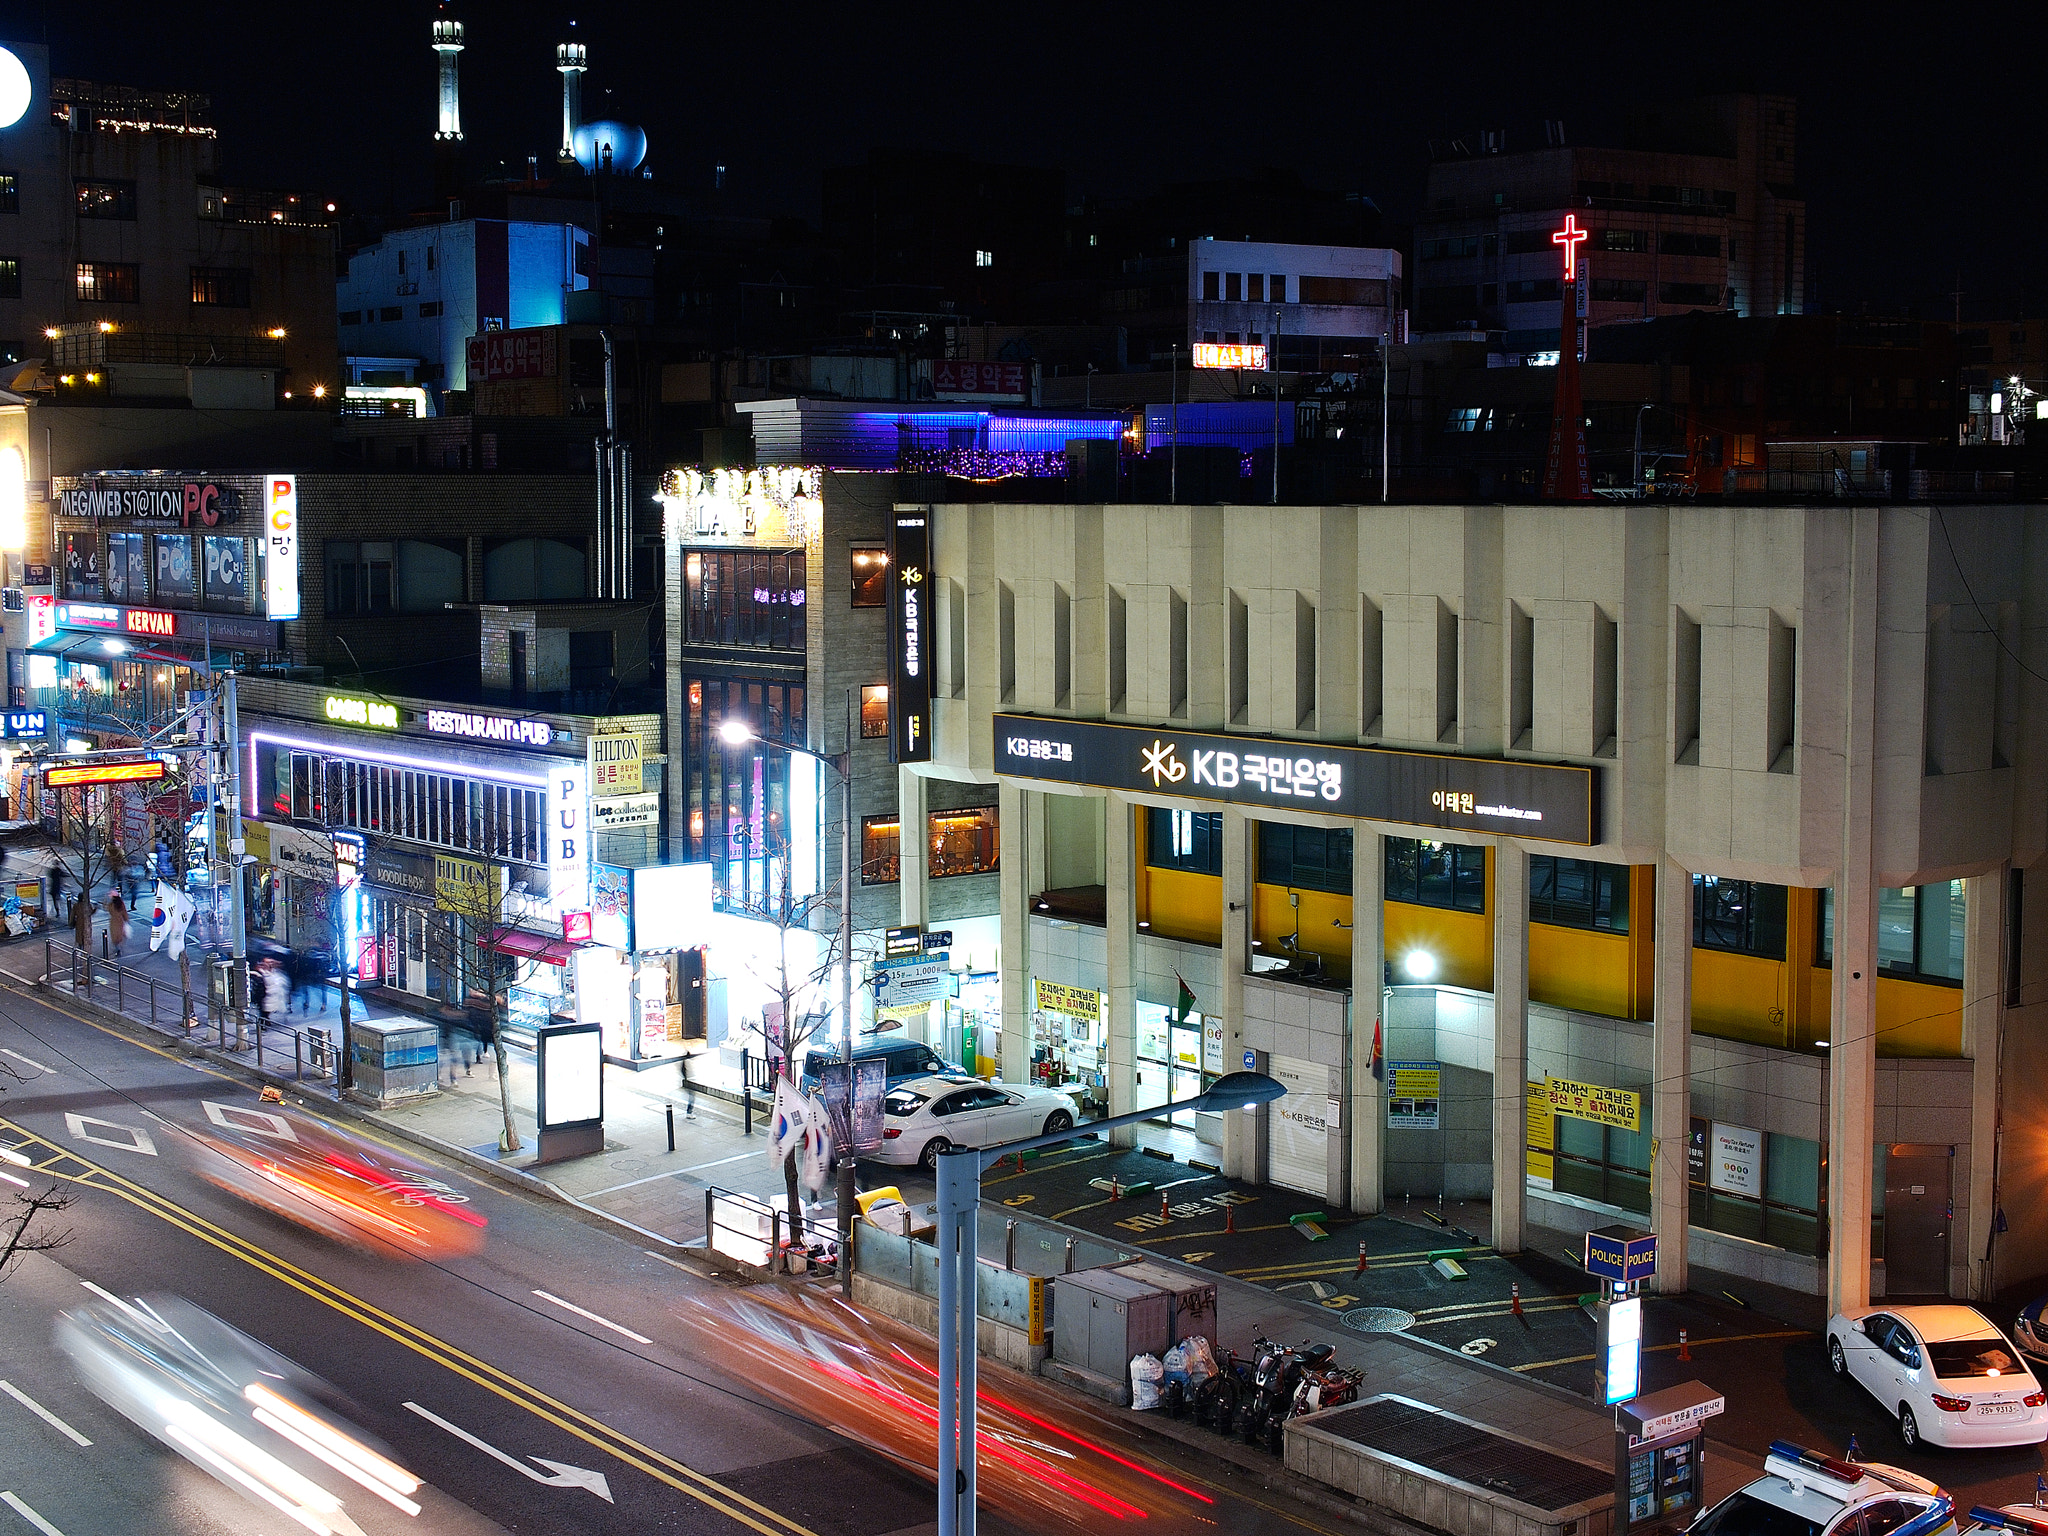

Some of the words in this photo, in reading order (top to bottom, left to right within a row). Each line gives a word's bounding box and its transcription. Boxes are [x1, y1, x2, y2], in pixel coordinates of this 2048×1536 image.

[469, 341, 488, 375] 약
[490, 336, 543, 374] 소명약국
[937, 364, 1024, 392] 소명약국
[60, 490, 122, 517] MEGAWEB
[127, 610, 173, 635] KERVAN
[368, 703, 398, 728] BAR
[594, 738, 639, 762] HILTON
[1007, 736, 1073, 762] KB금융그룹
[597, 765, 618, 784] 힐튼
[1193, 748, 1342, 801] KB국민은행
[595, 804, 613, 817] Lee
[1432, 790, 1473, 814] 이태원
[560, 779, 576, 859] PUB
[436, 859, 485, 886] HILTON
[875, 998, 889, 1008] 주차
[1039, 992, 1053, 1003] 정산
[1056, 996, 1062, 1005] 후
[1066, 998, 1098, 1012] 출차하세요
[1040, 982, 1065, 996] 주차하신
[1070, 988, 1095, 1002] 고객님은
[1549, 1091, 1568, 1105] 정산
[1574, 1096, 1583, 1108] 후
[1589, 1100, 1635, 1119] 출차하세요
[1552, 1079, 1588, 1098] 주차하신
[1594, 1088, 1632, 1106] 고객님은
[1292, 1112, 1326, 1128] KB국민은행
[1591, 1248, 1623, 1266] POLICE
[1628, 1250, 1654, 1267] POLICE
[1321, 1294, 1360, 1308] 5
[1460, 1337, 1498, 1355] 6
[1655, 1416, 1673, 1427] 이태원
[1674, 1410, 1691, 1423] 방문을
[1692, 1401, 1720, 1417] 환영합니다
